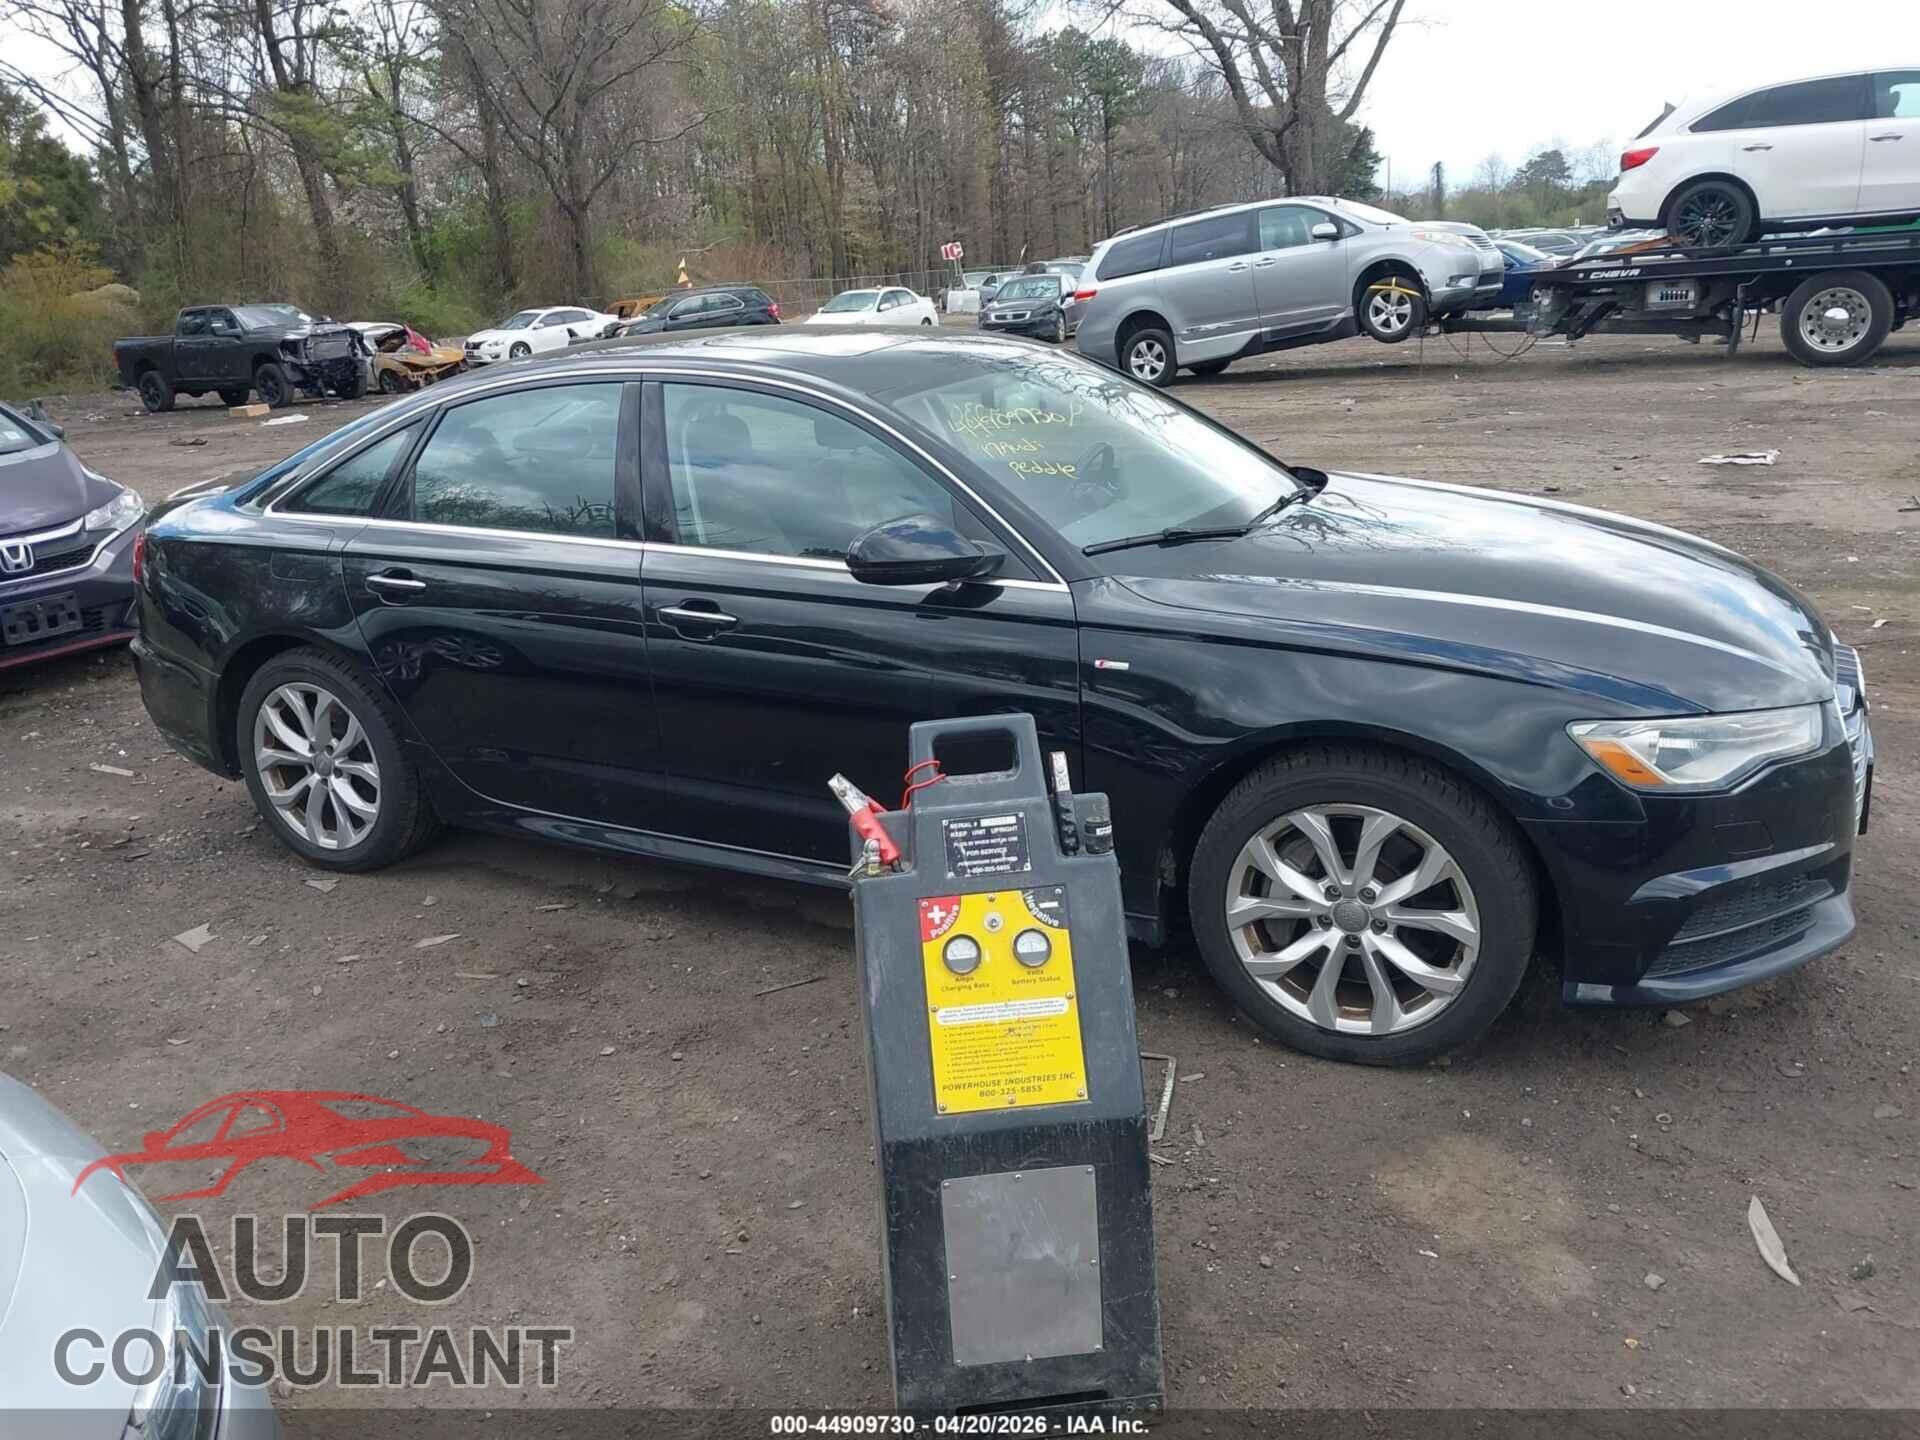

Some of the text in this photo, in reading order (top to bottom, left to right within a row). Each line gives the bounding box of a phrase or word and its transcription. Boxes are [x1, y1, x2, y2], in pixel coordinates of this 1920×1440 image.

[930, 904, 960, 939] Positive
[1025, 893, 1060, 928] Negative
[942, 1079, 1001, 1092] POWERHOUSE
[1004, 1073, 1057, 1086] INDUSTRIES
